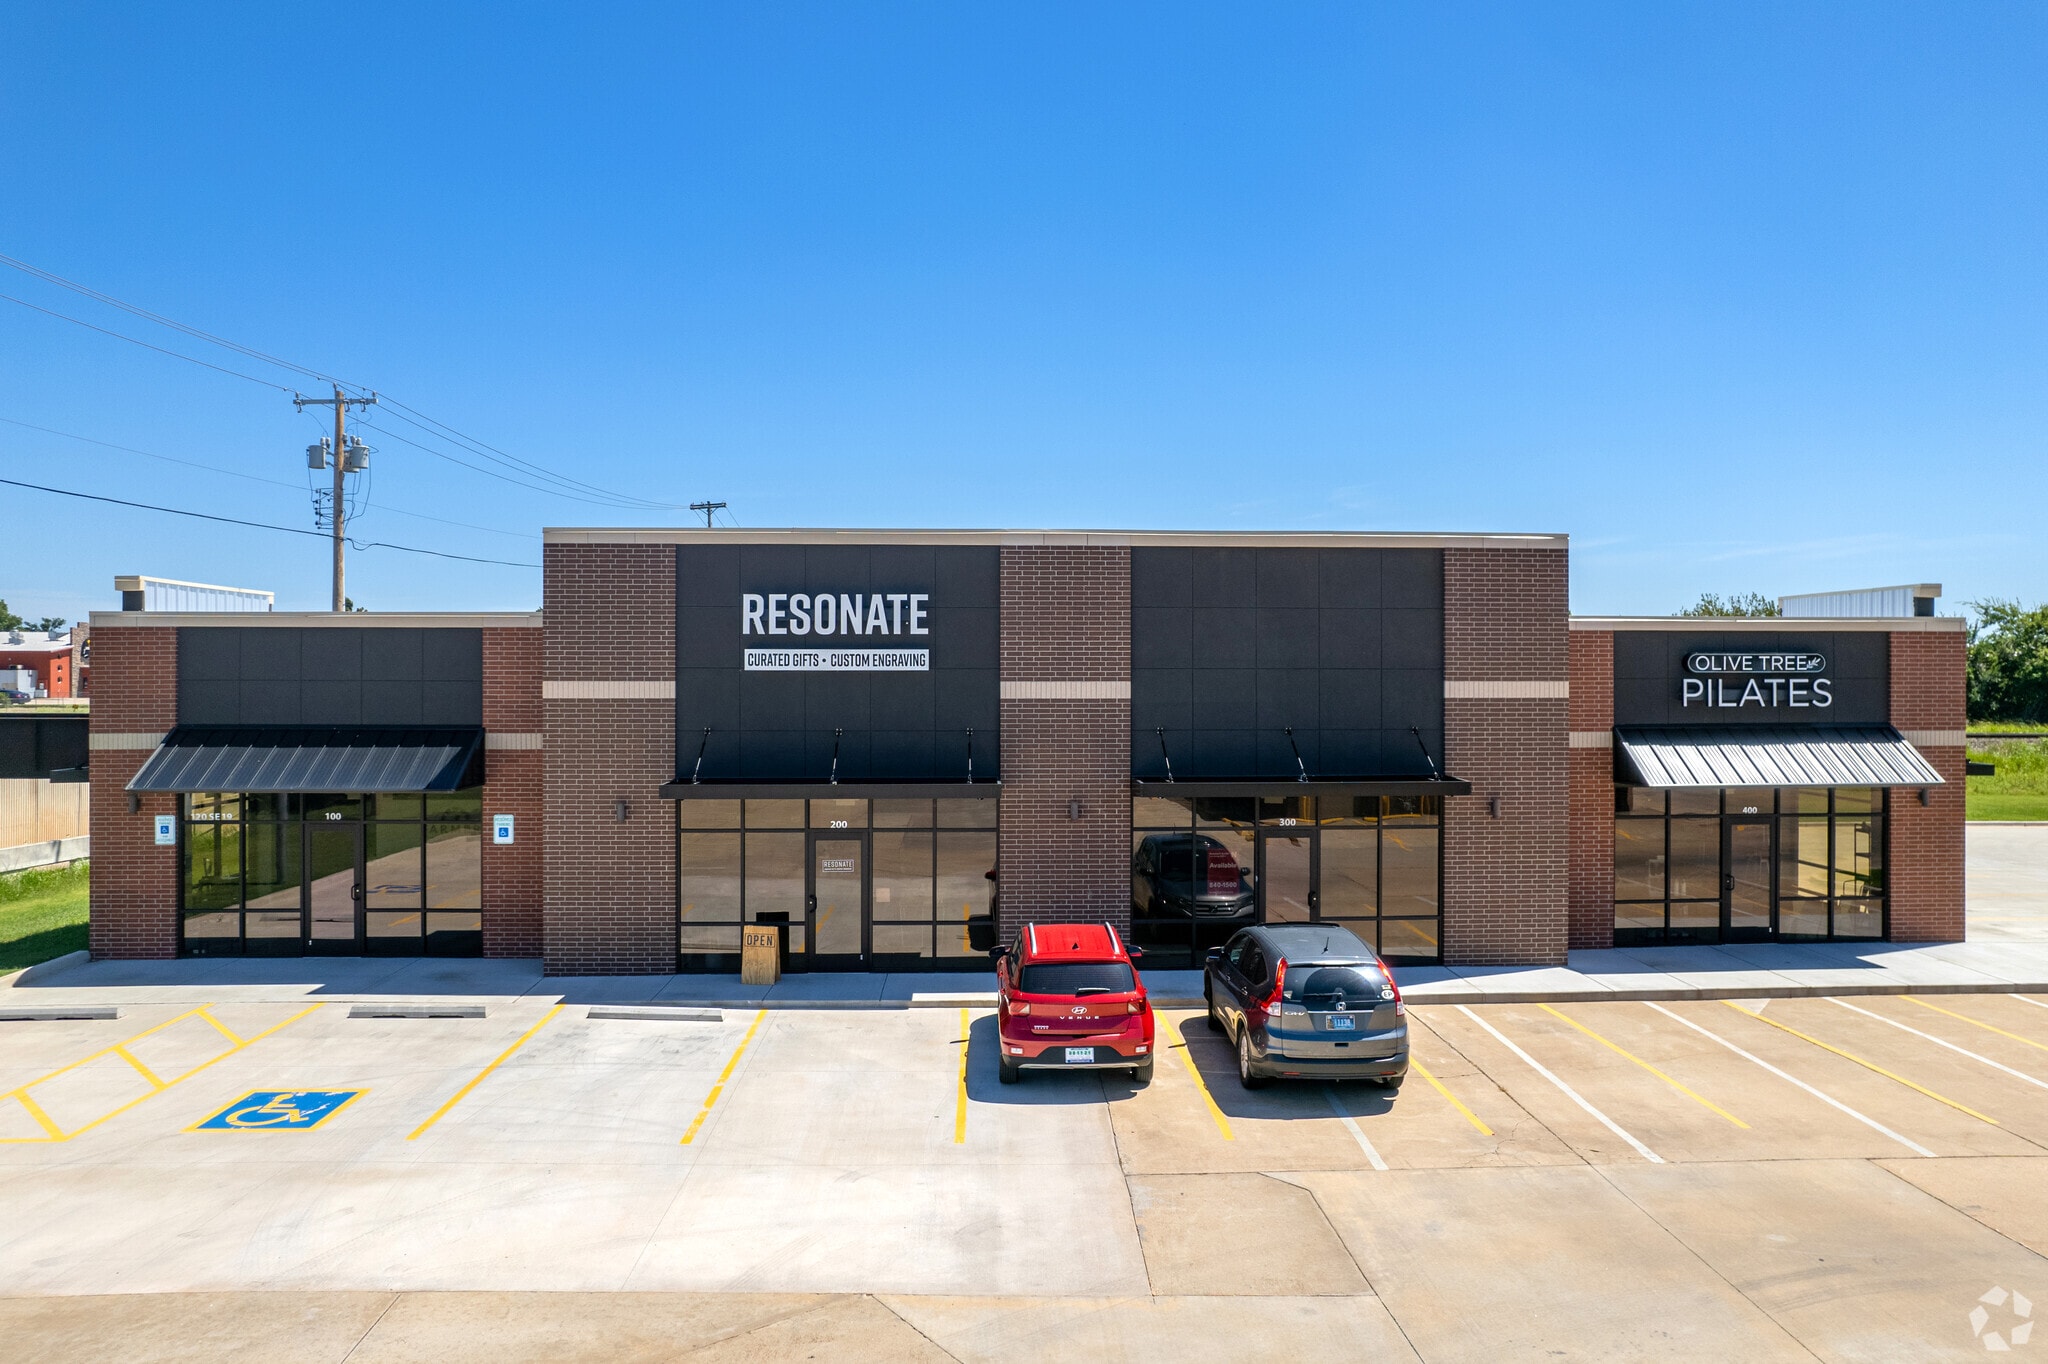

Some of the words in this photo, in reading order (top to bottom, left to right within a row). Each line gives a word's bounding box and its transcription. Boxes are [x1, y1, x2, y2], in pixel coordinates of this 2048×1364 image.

[742, 593, 929, 635] RESONATE
[747, 653, 790, 667] CURATED
[792, 653, 819, 667] GIFTS
[830, 653, 870, 667] CUSTOM
[872, 653, 926, 667] ENGRAVING
[1695, 655, 1753, 671] OLIVE
[1758, 655, 1808, 671] TREE
[1682, 678, 1833, 707] PILATES
[1742, 806, 1758, 814] 400
[191, 813, 207, 821] 120
[209, 813, 220, 821] SE
[324, 812, 342, 821] 100
[830, 820, 848, 829] 200
[1279, 818, 1296, 827] 300
[746, 934, 773, 946] OPEN
